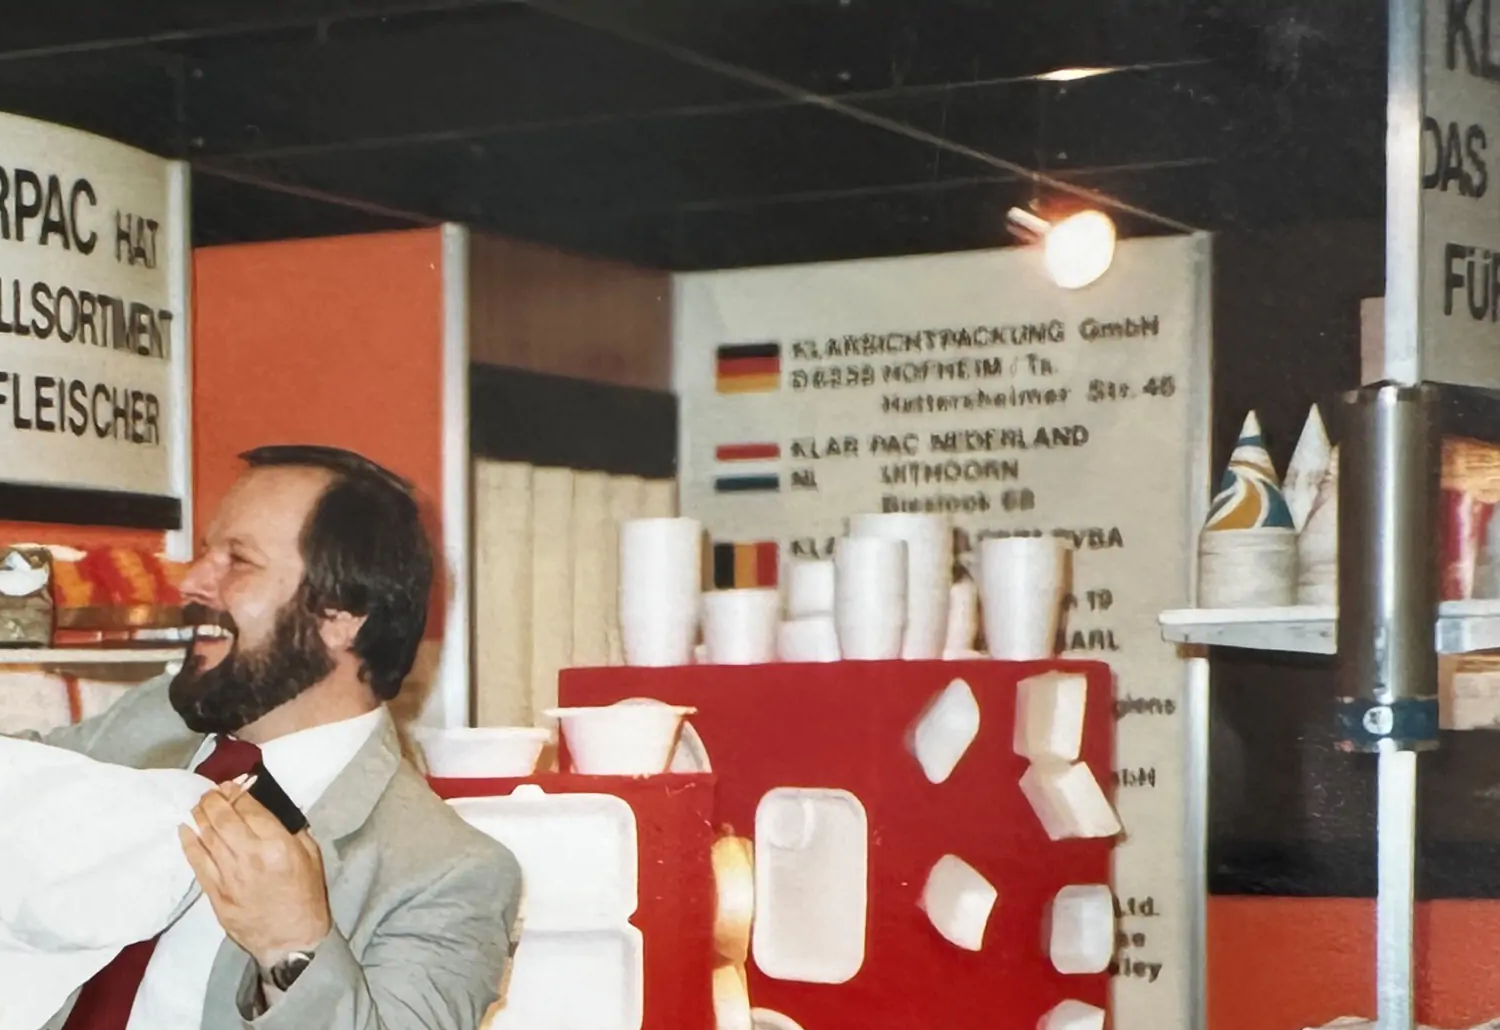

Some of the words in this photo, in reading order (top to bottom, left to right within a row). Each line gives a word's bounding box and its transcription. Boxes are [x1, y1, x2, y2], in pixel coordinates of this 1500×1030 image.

[1421, 116, 1488, 199] DAS
[115, 209, 159, 268] HAT
[1078, 314, 1159, 343] GmbH
[880, 355, 1002, 385] HOFHEIM
